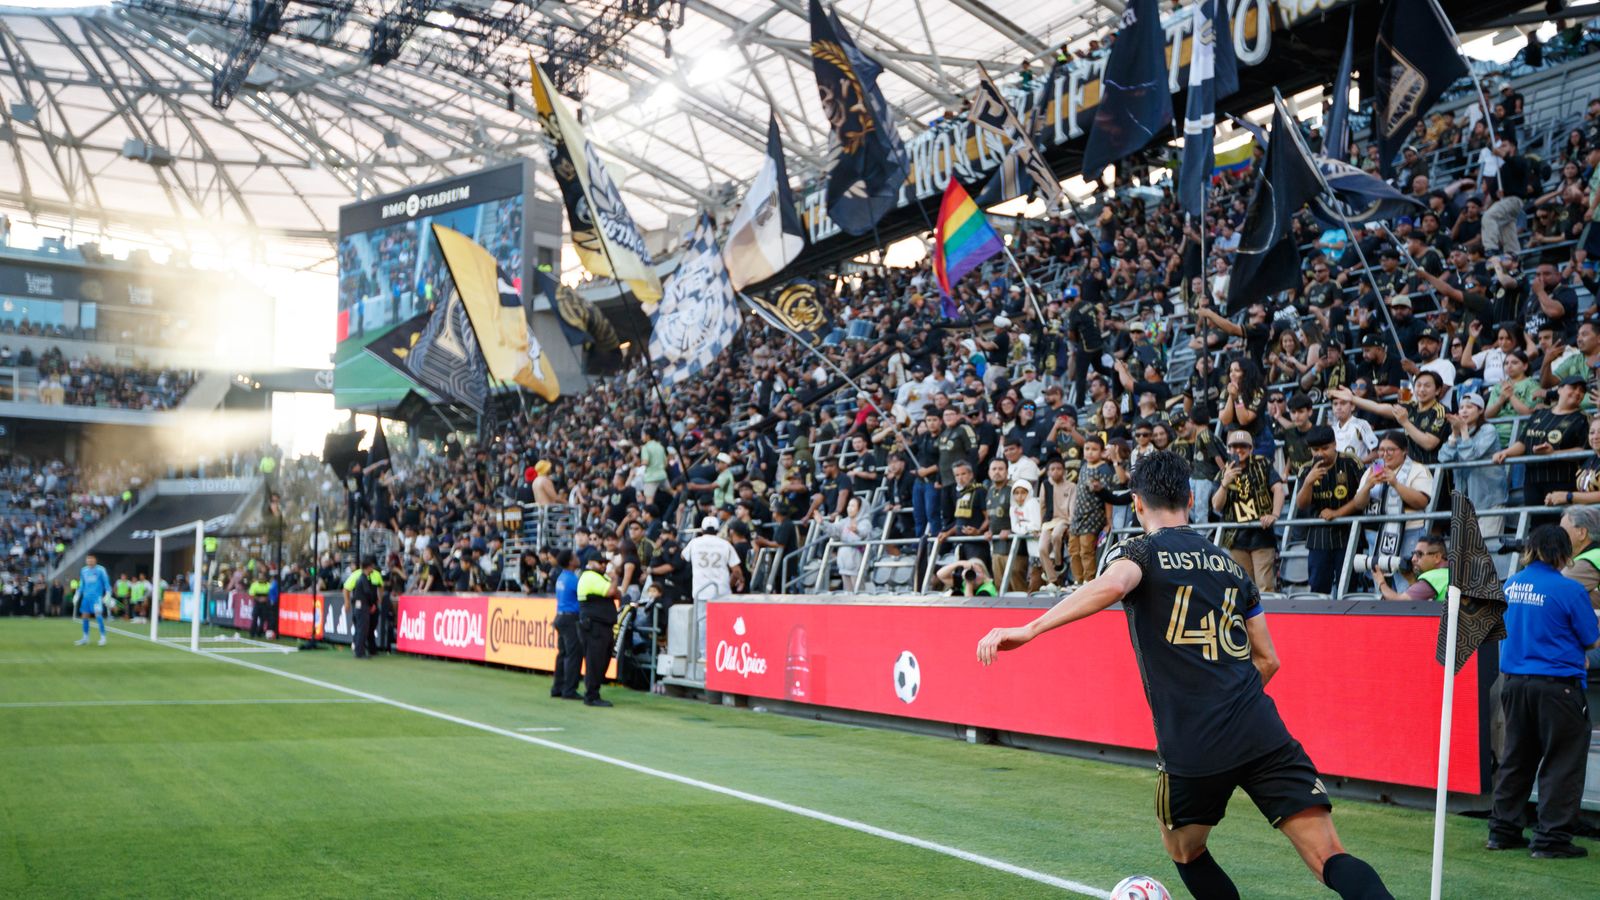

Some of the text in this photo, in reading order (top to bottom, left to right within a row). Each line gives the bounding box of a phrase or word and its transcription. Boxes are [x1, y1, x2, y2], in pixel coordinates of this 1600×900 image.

[382, 185, 470, 219] BMO STADIUM
[201, 481, 240, 490] TOYOTA
[698, 551, 722, 569] 32
[1505, 581, 1534, 595] ALLIED
[1509, 591, 1544, 603] UNIVERSAL
[400, 610, 426, 641] Audi
[490, 607, 556, 653] Continenta
[1165, 585, 1252, 661] 46
[715, 640, 767, 679] Old Spice
